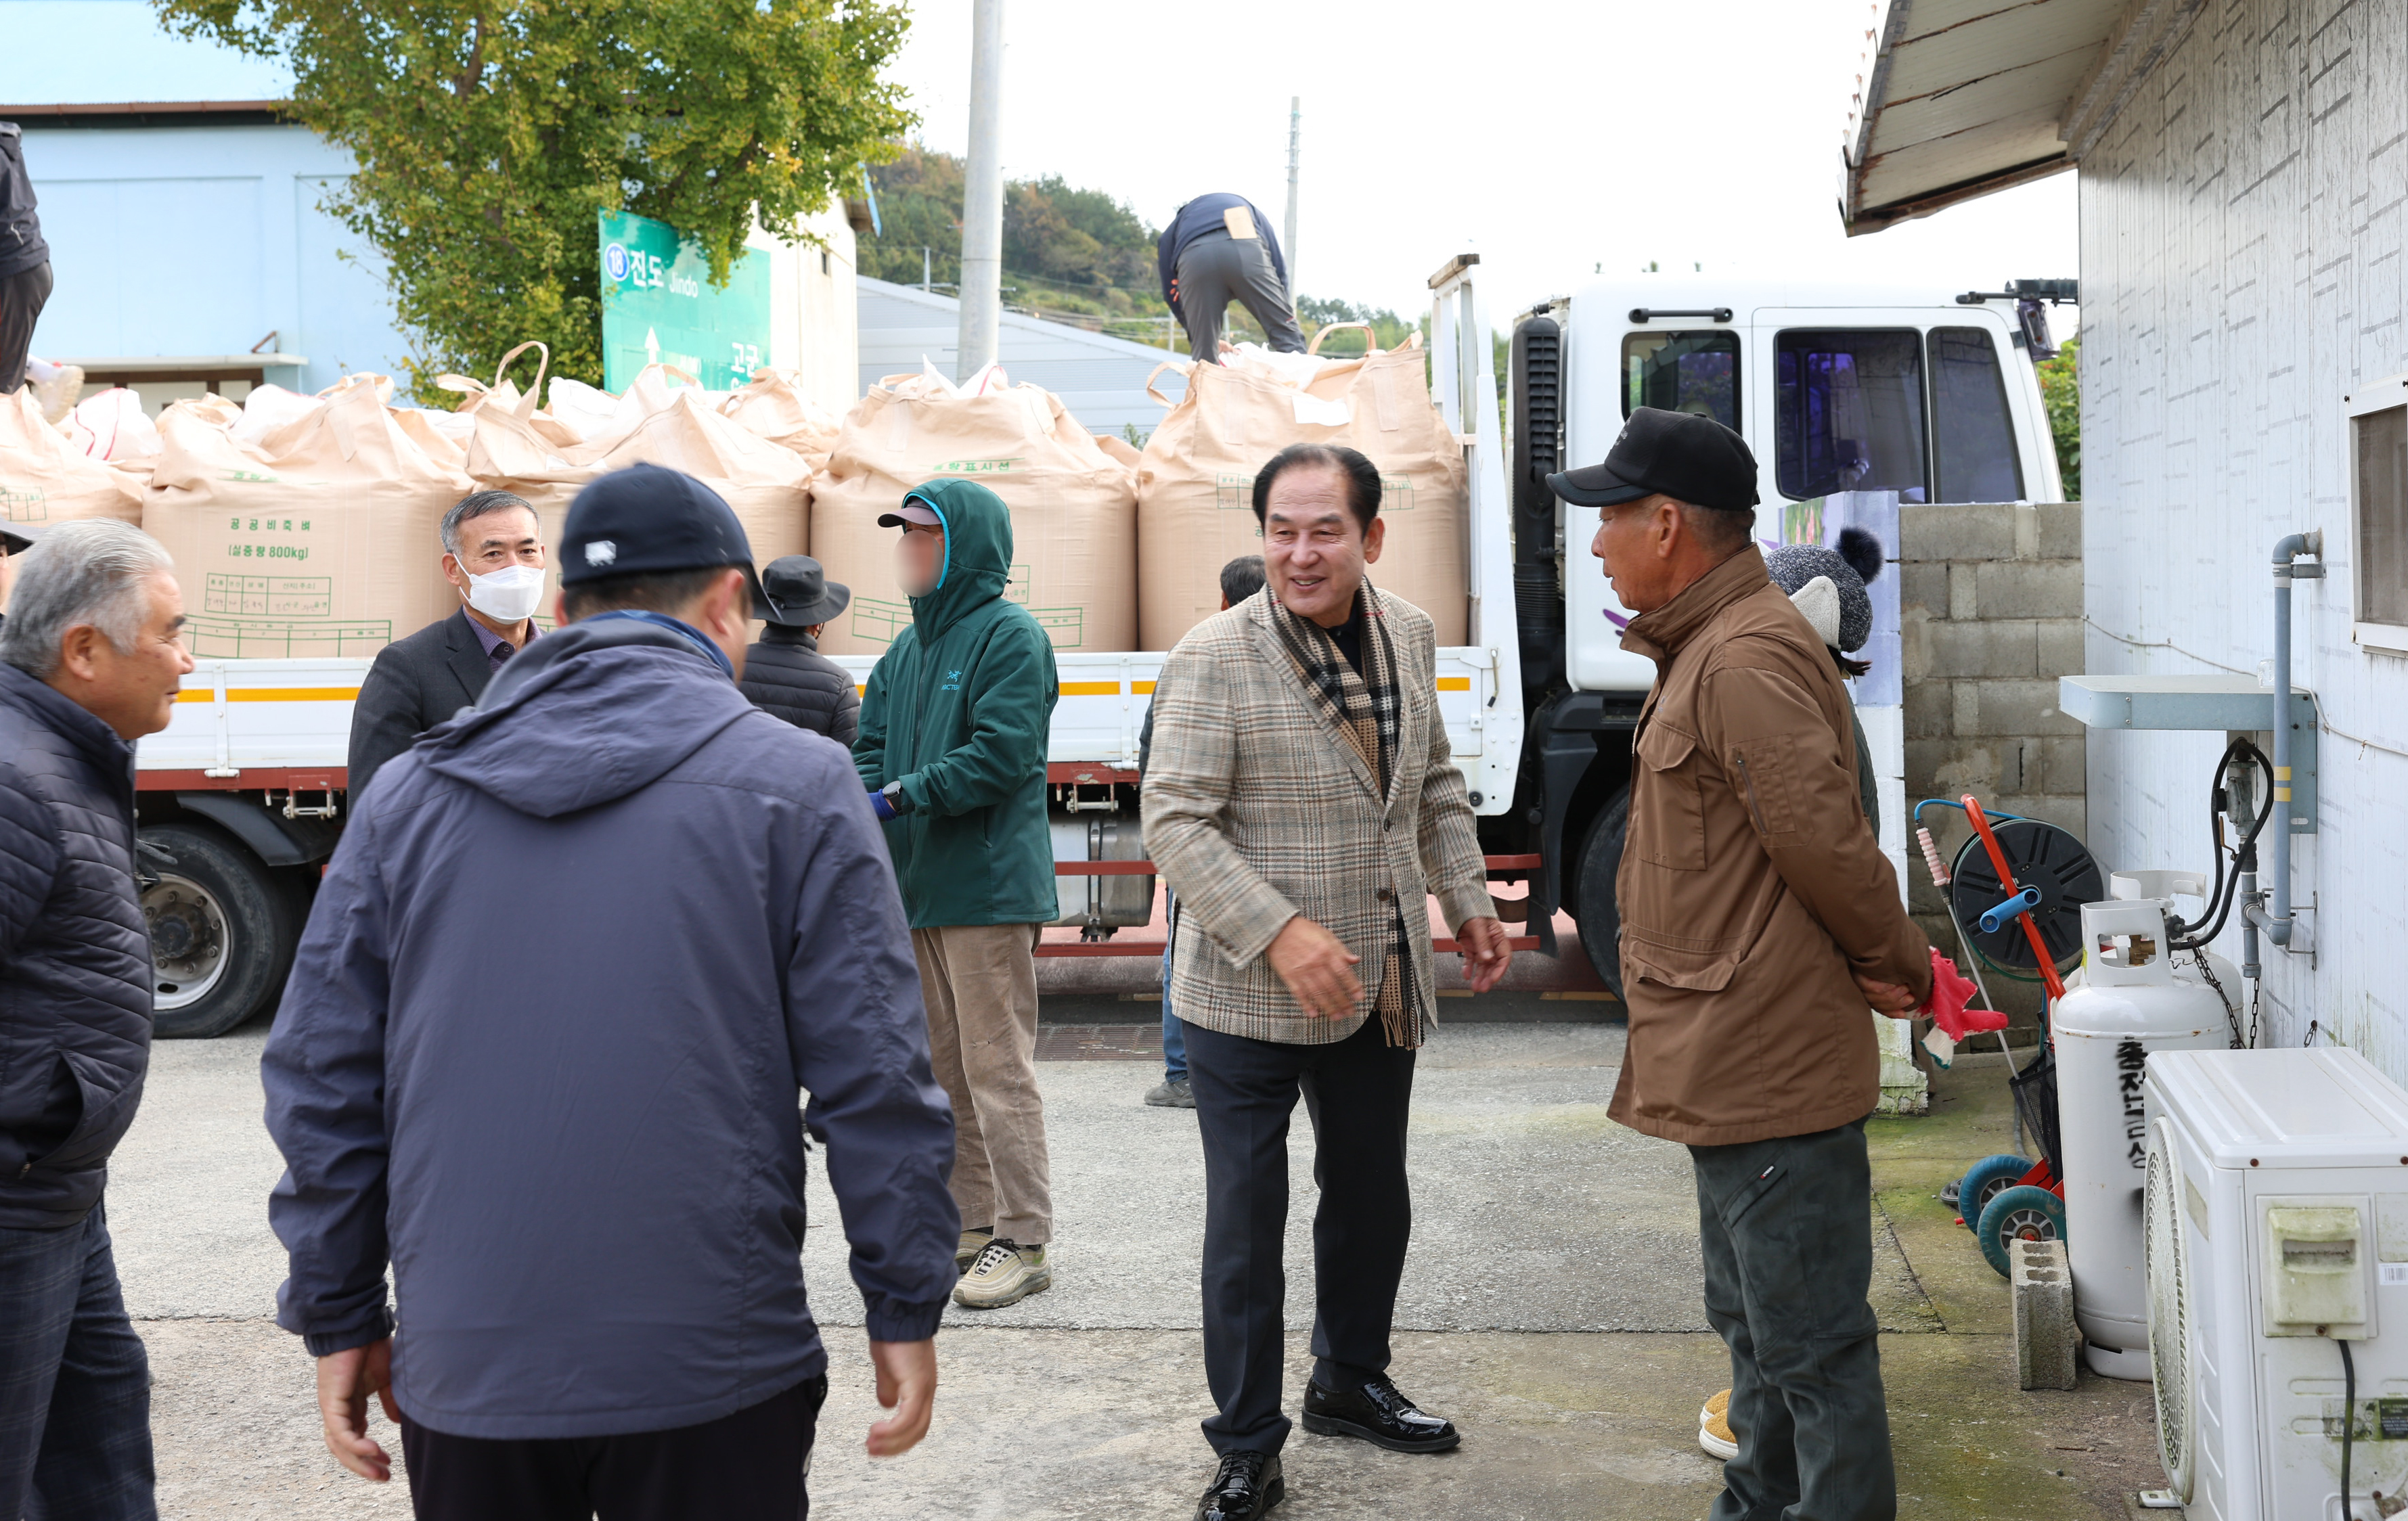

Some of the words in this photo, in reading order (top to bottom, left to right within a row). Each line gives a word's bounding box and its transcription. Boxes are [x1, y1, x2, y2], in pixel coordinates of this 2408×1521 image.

[610, 250, 623, 275] 18
[630, 250, 665, 288] 진도
[669, 272, 698, 298] Jindo
